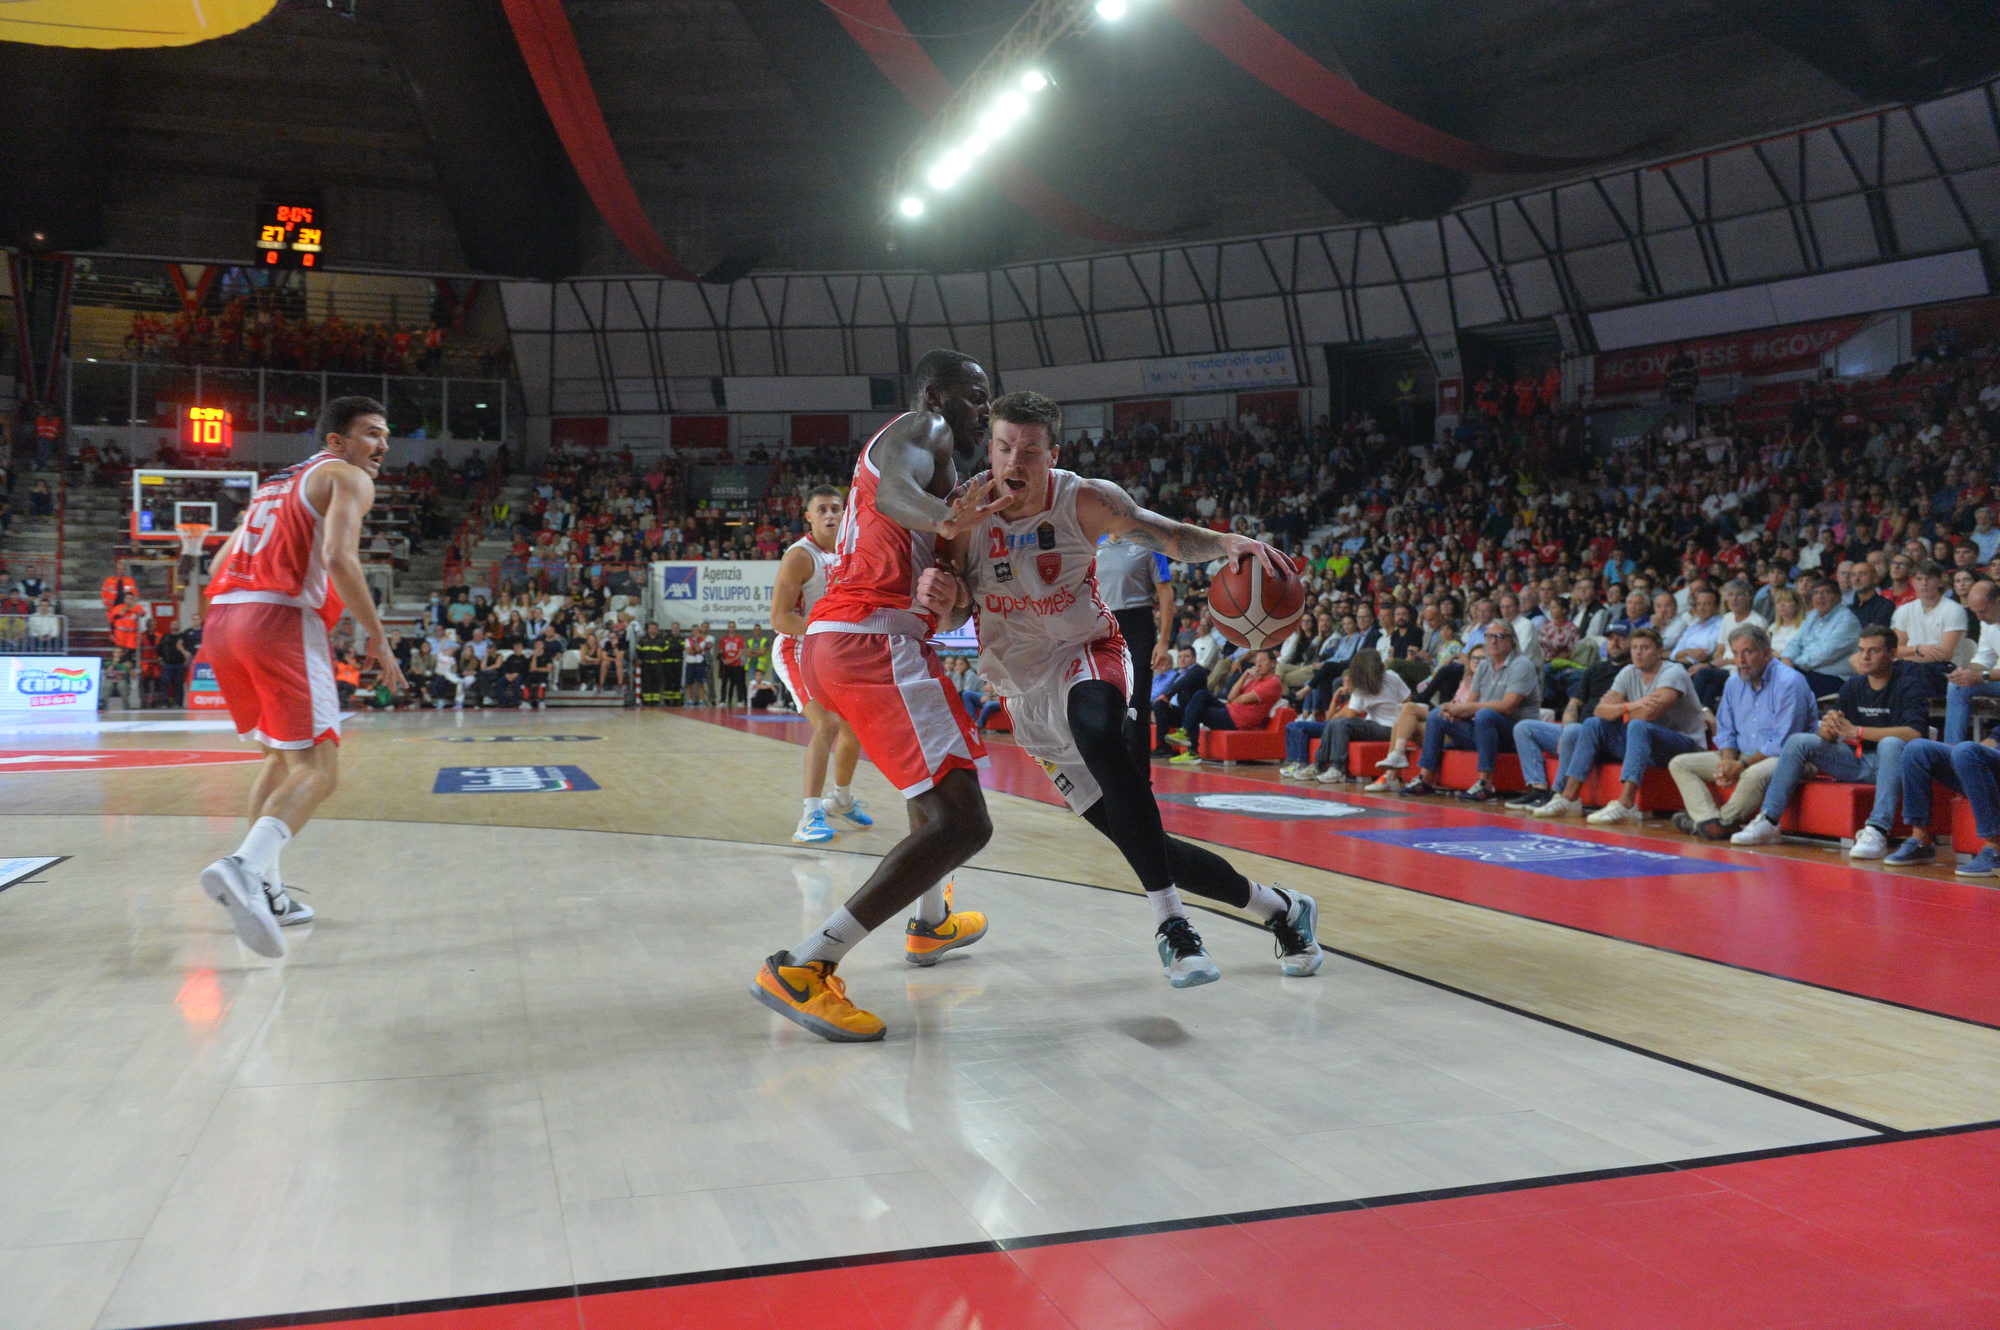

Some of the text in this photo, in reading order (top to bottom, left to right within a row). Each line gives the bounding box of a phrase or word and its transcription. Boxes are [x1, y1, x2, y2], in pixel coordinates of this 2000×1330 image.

[262, 226, 285, 242] 27
[298, 228, 322, 245] 34
[193, 421, 221, 443] 10
[232, 499, 283, 556] 15
[702, 566, 742, 583] Agenzia
[664, 583, 692, 598] AXA
[702, 586, 751, 600] SVILUPPO
[753, 586, 761, 600] &
